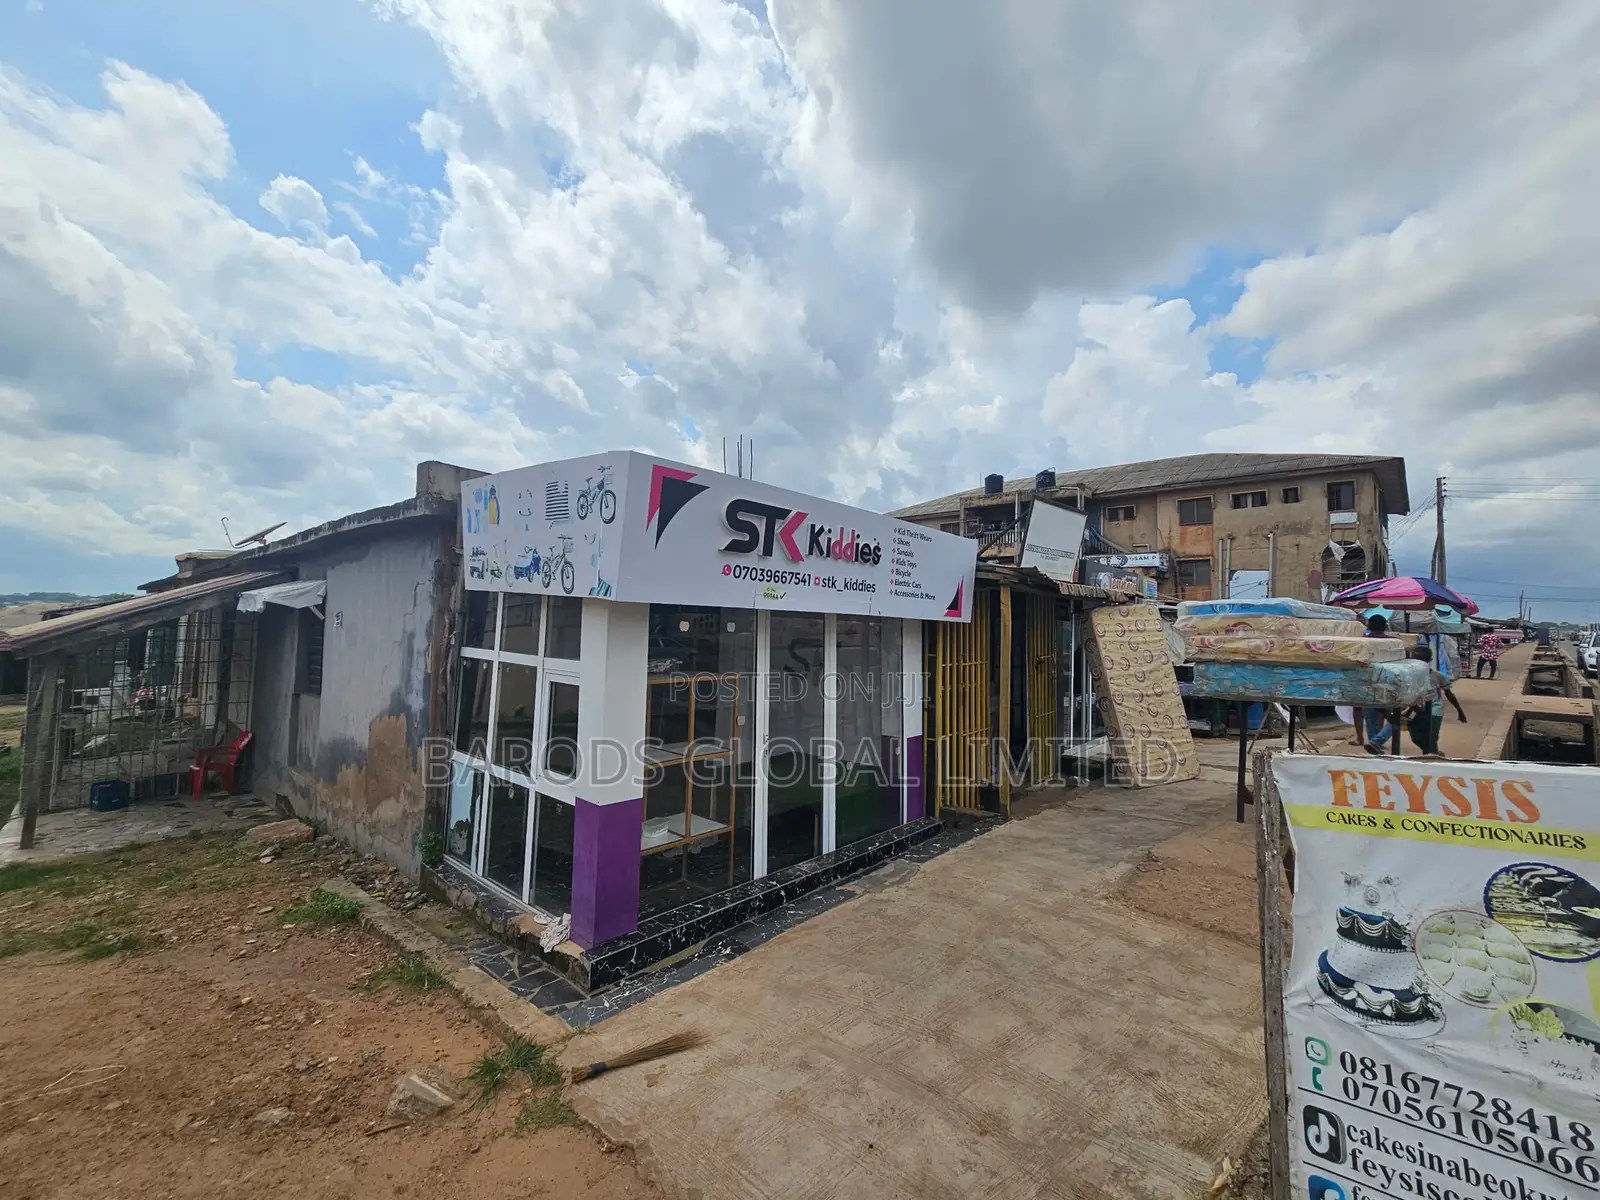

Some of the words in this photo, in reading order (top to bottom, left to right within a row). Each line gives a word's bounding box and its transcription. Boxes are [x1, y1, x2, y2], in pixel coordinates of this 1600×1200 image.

[720, 498, 809, 562] STK
[808, 523, 882, 565] Kiddies
[897, 537, 911, 547] Shoes
[898, 527, 906, 536] Kid
[907, 530, 919, 539] Thrift
[919, 533, 933, 543] Wears
[895, 558, 906, 567] Kids
[907, 560, 917, 569] Toys
[896, 547, 914, 558] Sandals
[733, 564, 811, 587] 07039667541
[821, 575, 876, 593] stk_kiddies
[894, 579, 911, 588] Electric
[912, 581, 922, 589] Cars
[895, 568, 912, 578] Bicycle
[894, 589, 919, 599] Accessories
[925, 593, 936, 601] More
[1327, 769, 1541, 824] FEYSIS
[1326, 811, 1377, 829] CAKES
[1383, 817, 1396, 830] &
[1401, 817, 1587, 850] CONFECTIONARIES
[1339, 1050, 1595, 1152] 08167728418
[1342, 1076, 1600, 1183] 07056105066
[1347, 1124, 1568, 1200] cakesinabeok
